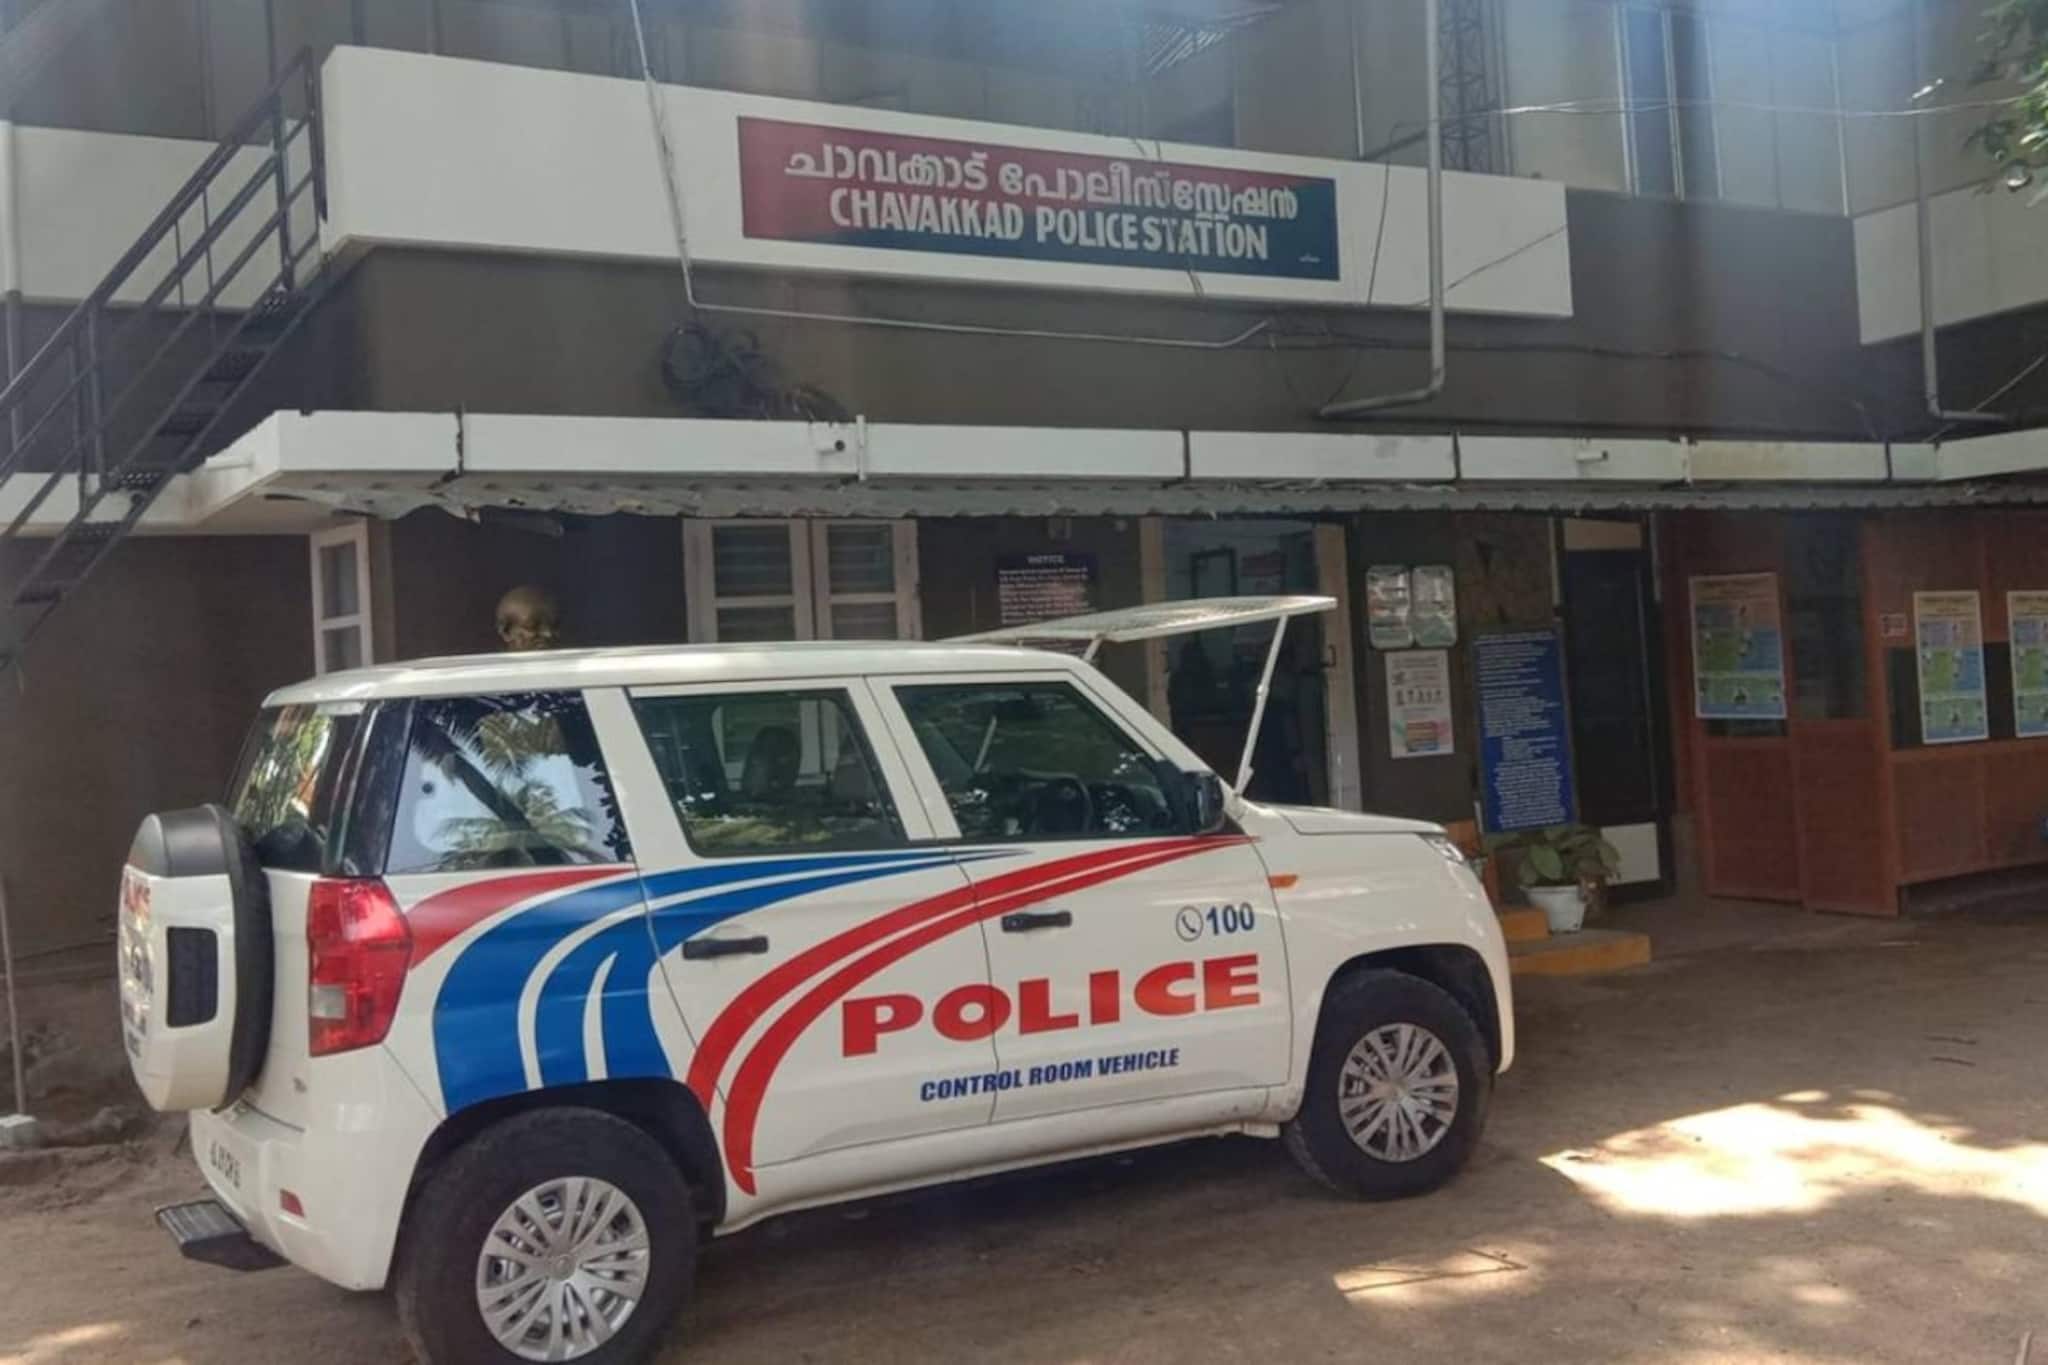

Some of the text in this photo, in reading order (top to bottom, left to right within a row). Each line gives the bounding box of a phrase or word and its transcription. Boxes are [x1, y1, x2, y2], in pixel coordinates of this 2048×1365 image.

[784, 143, 989, 191] ചാവക്കാട്
[829, 187, 1269, 260] CHAVAKKAD POLICE STATION
[1206, 902, 1255, 935] 100
[842, 953, 1260, 1058] POLICE
[920, 1048, 1180, 1102] CONTROL ROOM VEHICLE
